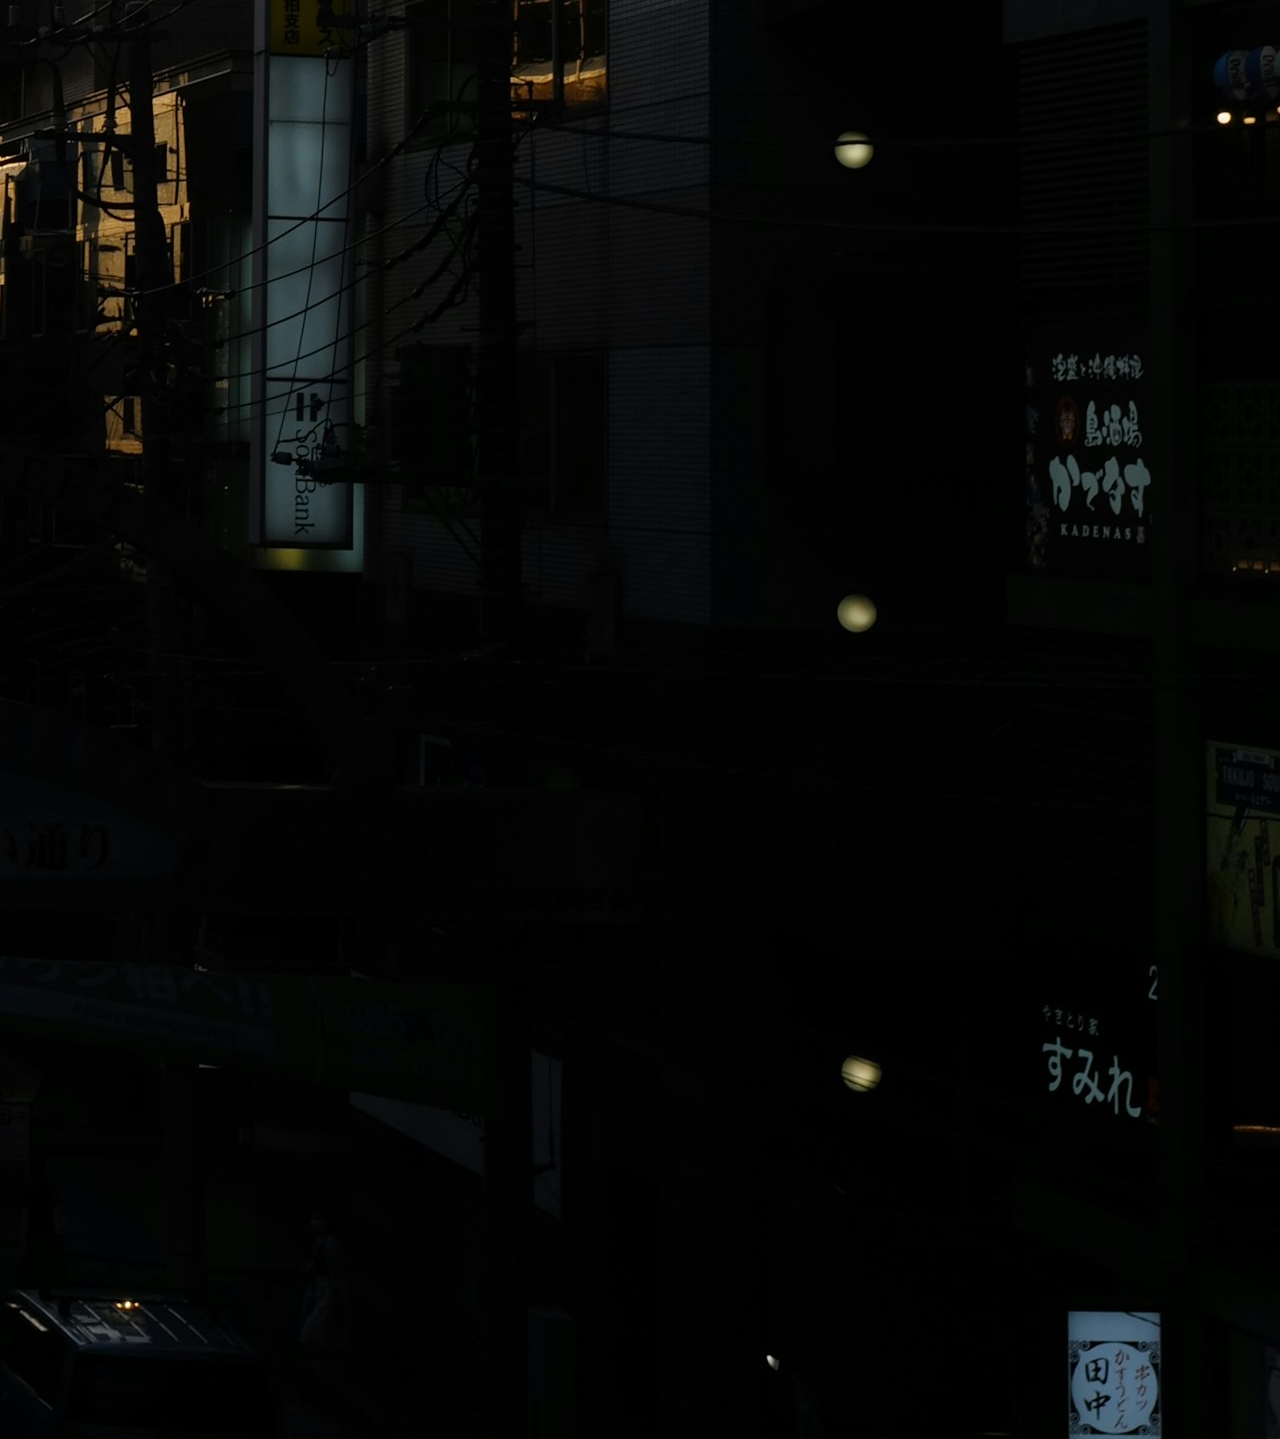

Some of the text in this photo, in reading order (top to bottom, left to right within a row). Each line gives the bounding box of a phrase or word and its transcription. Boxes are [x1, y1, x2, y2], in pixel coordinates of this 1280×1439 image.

[294, 429, 318, 536] SoBank
[1060, 523, 1132, 541] KADENAS
[1041, 1035, 1143, 1119] すみれ
[1083, 1356, 1111, 1421] 田中
